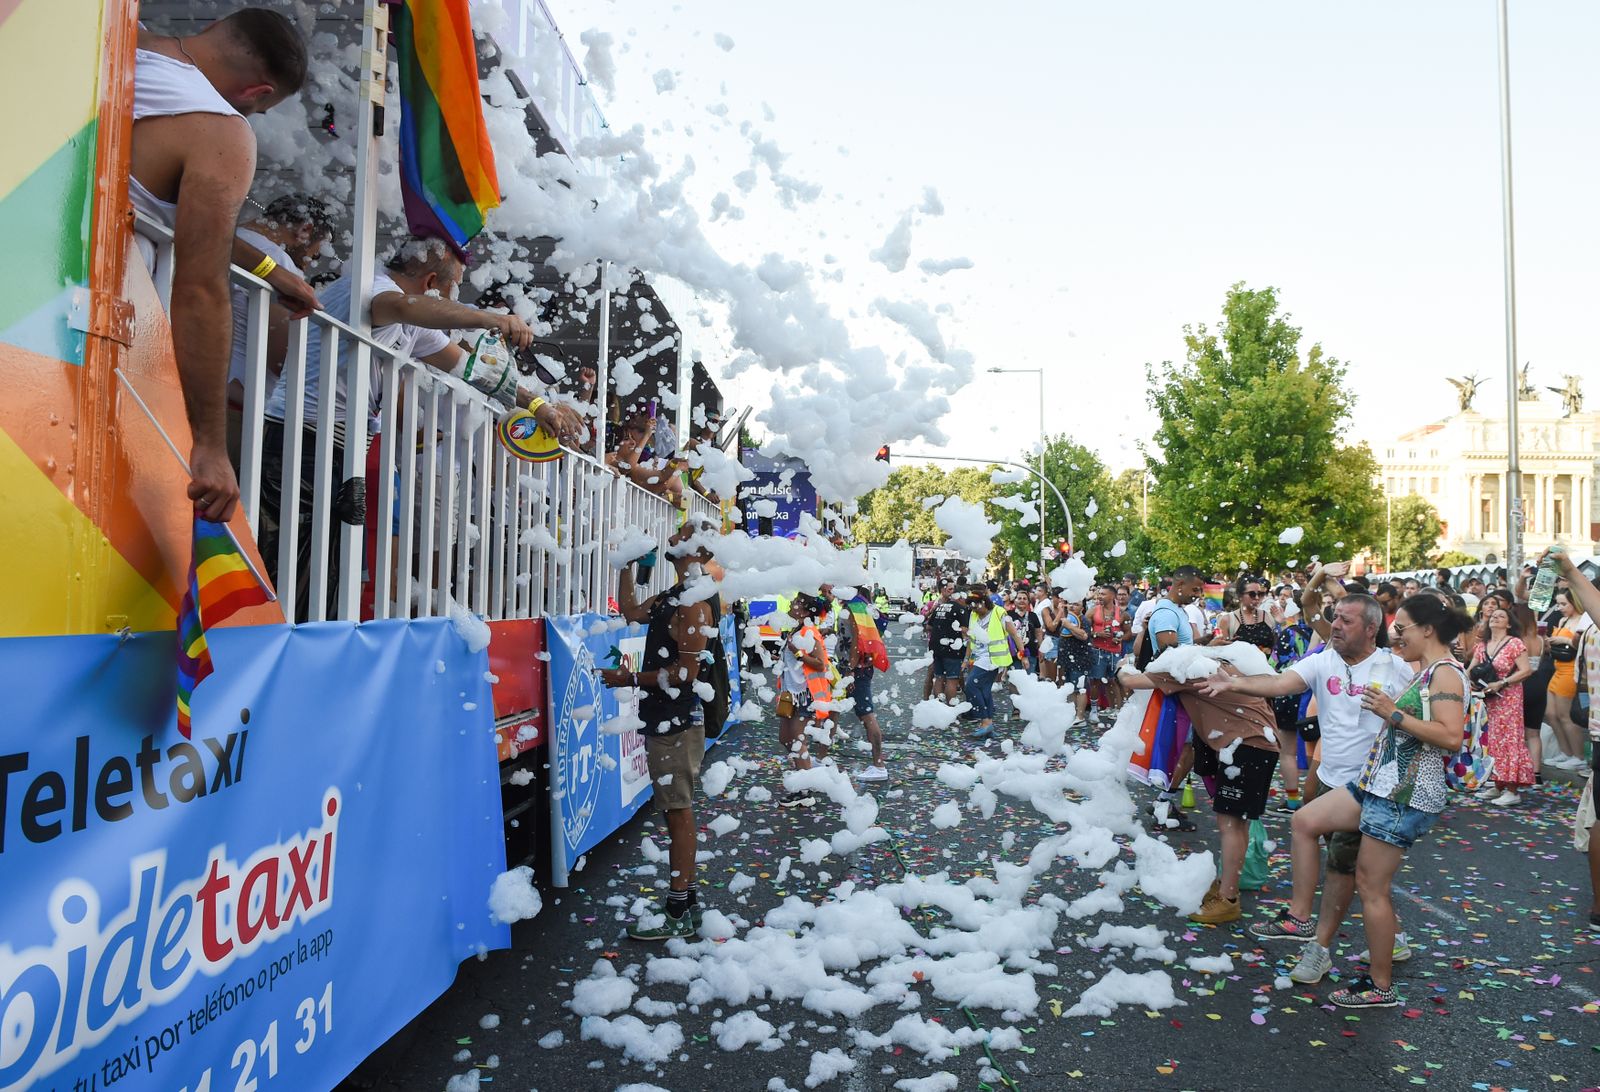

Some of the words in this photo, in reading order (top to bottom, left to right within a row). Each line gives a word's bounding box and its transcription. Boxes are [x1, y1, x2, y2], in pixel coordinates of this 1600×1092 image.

[758, 484, 792, 495] usic
[0, 707, 250, 854] Teletaxi
[101, 1035, 141, 1088] taxi
[144, 1020, 183, 1073] por
[187, 978, 255, 1035] teléfono
[257, 969, 267, 989] o
[270, 951, 295, 992] por
[297, 938, 308, 965] la
[310, 928, 333, 962] app
[230, 1019, 278, 1092] 21
[294, 980, 333, 1055] 31
